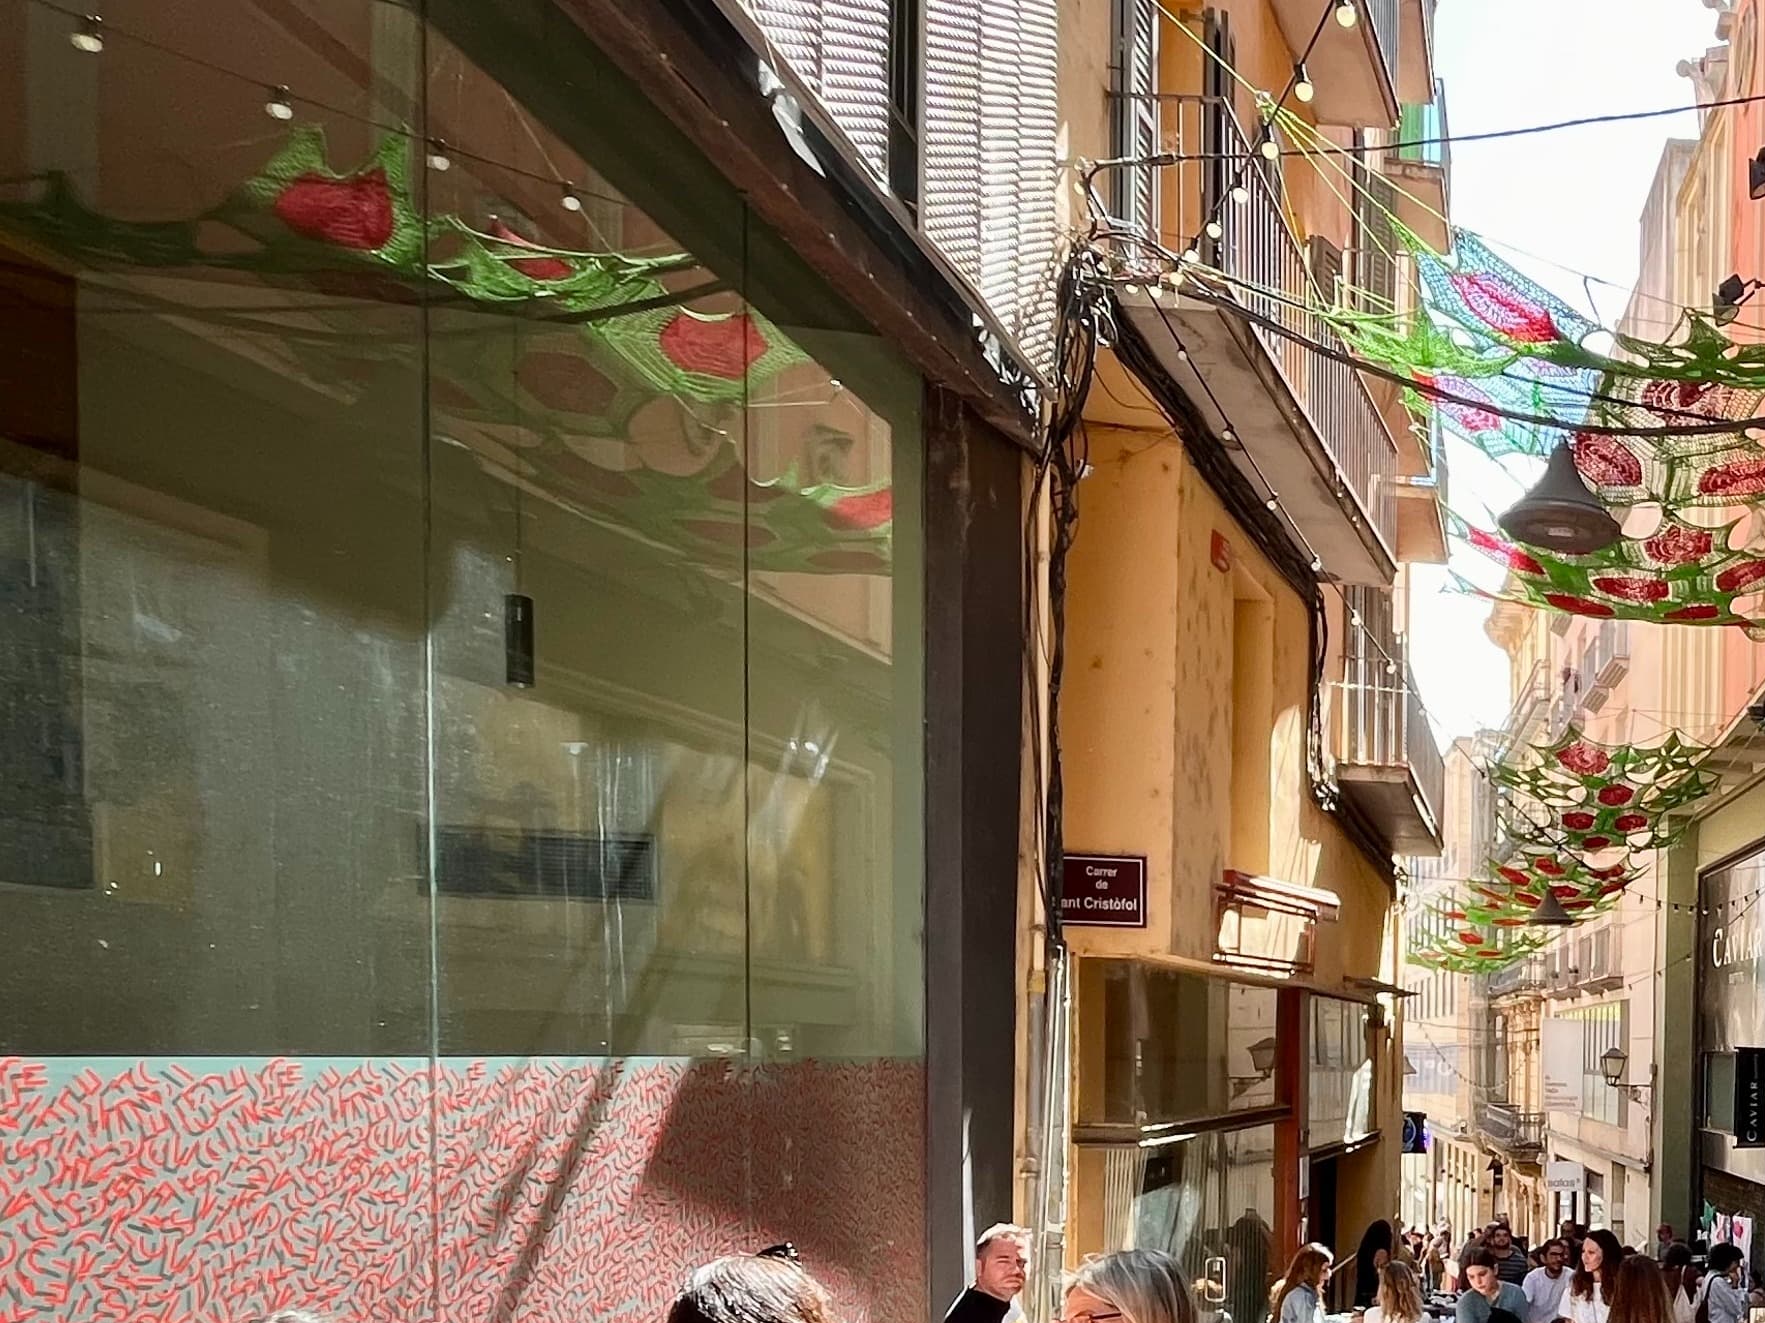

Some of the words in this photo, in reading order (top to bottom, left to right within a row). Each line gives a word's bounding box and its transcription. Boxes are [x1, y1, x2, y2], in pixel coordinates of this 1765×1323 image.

[1086, 865, 1118, 878] Carrer
[1095, 879, 1109, 890] de
[1060, 897, 1081, 909] ant
[1083, 896, 1138, 911] Cristòfol
[1712, 928, 1762, 968] CAVIAR
[1746, 1081, 1759, 1142] CAVIAR
